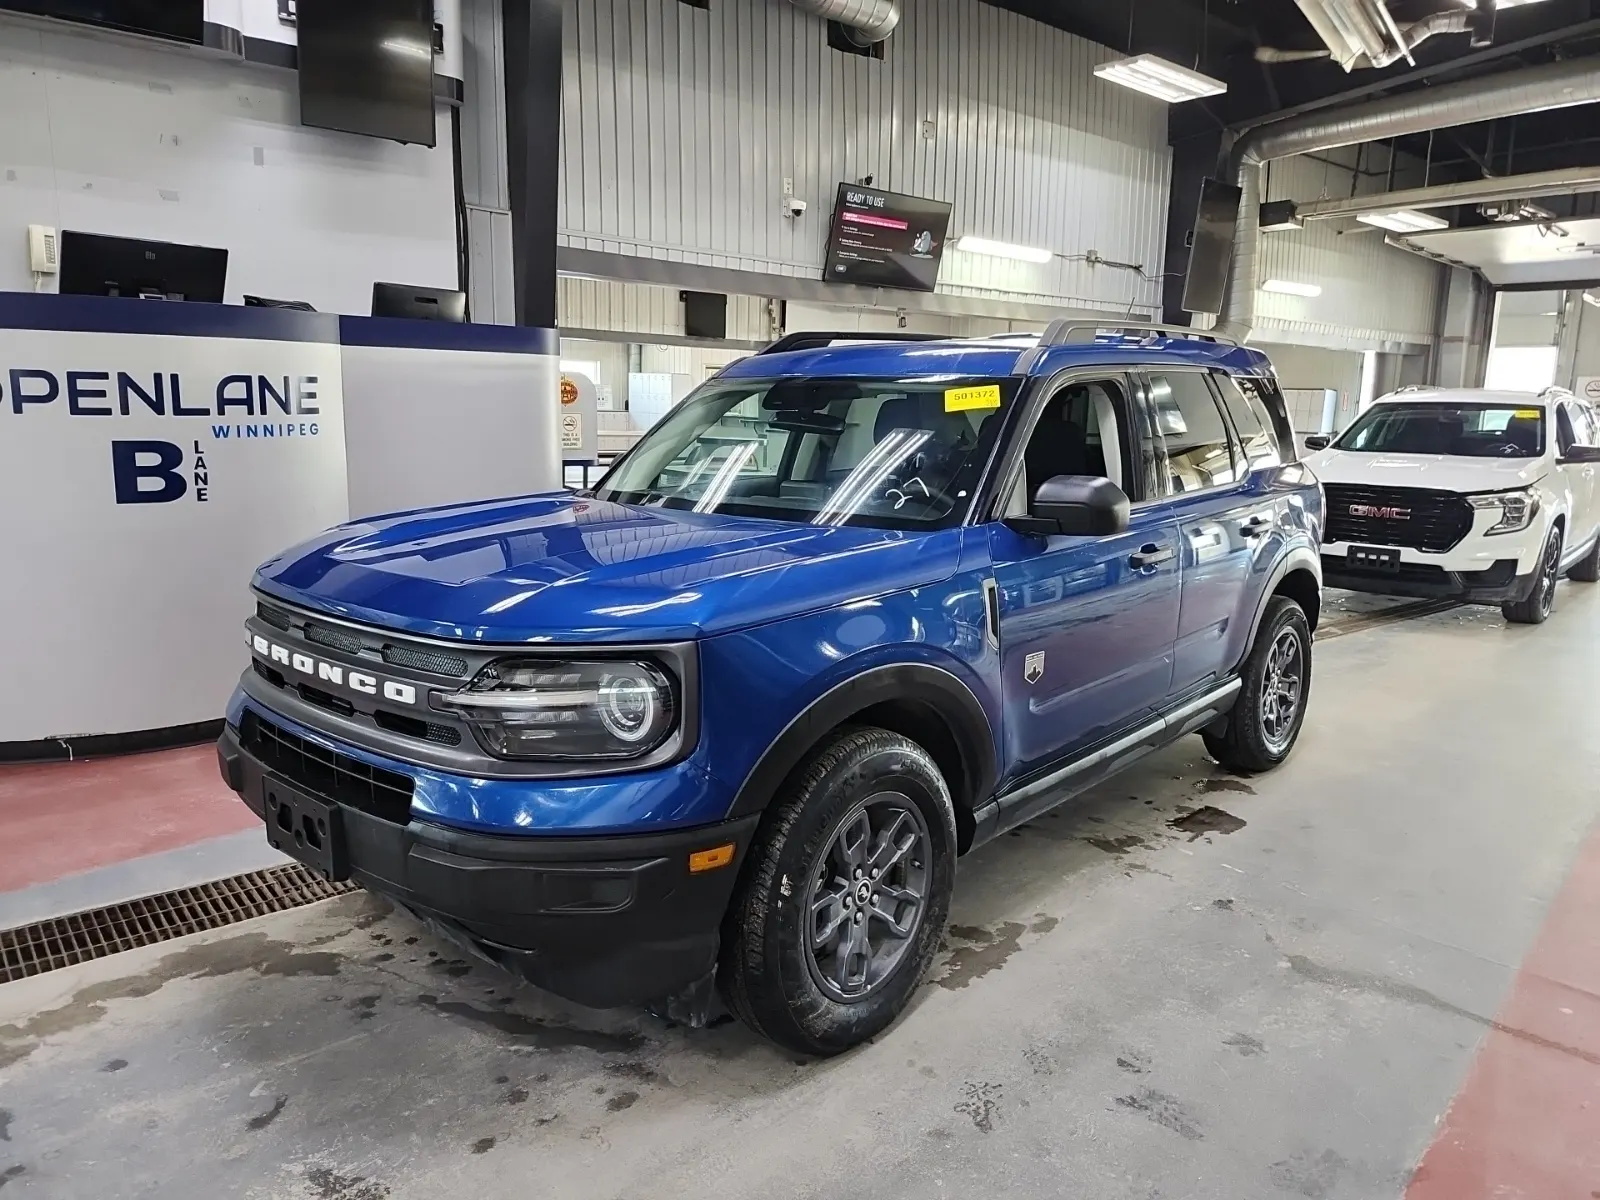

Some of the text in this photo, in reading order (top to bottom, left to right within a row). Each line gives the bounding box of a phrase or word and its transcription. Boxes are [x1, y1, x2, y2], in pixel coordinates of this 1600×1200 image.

[846, 191, 866, 204] READY
[866, 195, 874, 206] TO
[874, 197, 885, 208] USE
[0, 368, 320, 417] PENLANE
[954, 390, 996, 401] 501372
[211, 423, 320, 439] WINNIPEG
[111, 440, 188, 504] B
[193, 440, 209, 502] LANE
[1349, 504, 1412, 520] GMC
[253, 635, 416, 704] BRONCO
